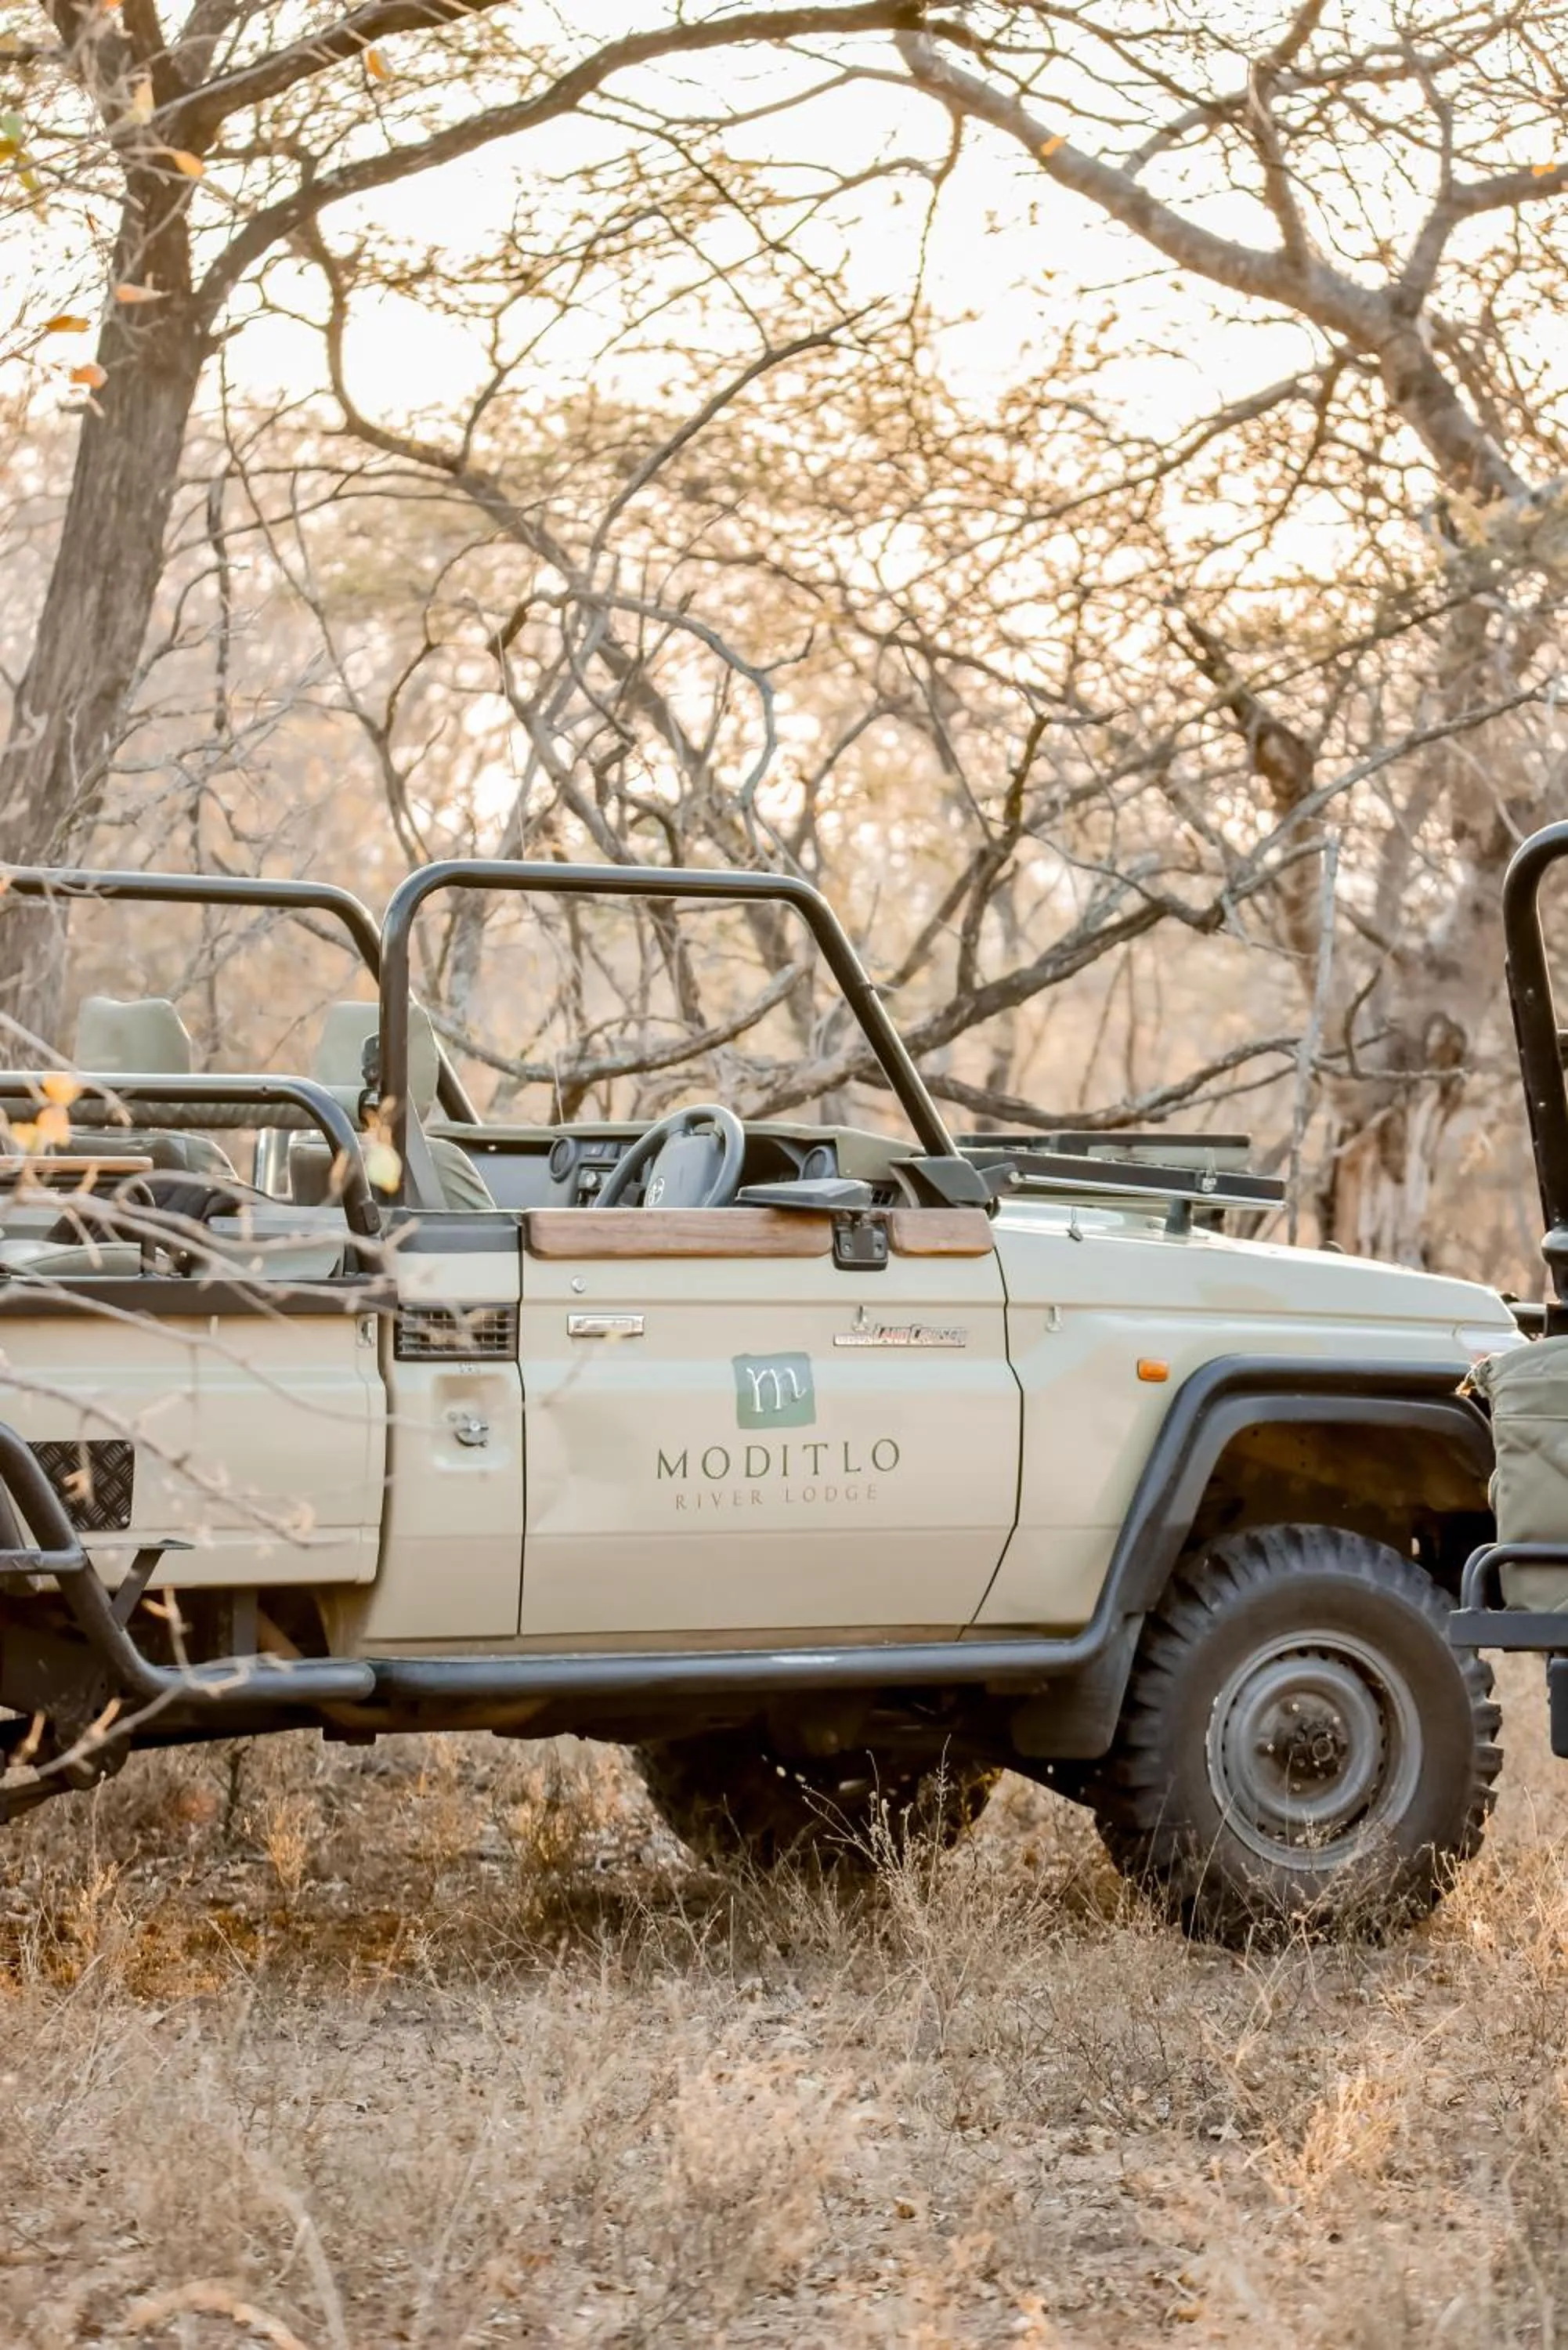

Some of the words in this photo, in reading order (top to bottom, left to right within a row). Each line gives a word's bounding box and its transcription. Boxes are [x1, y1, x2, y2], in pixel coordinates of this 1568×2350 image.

[657, 1438, 900, 1480] MODITLO
[675, 1490, 764, 1511] RIVER
[784, 1484, 880, 1504] LODGE
